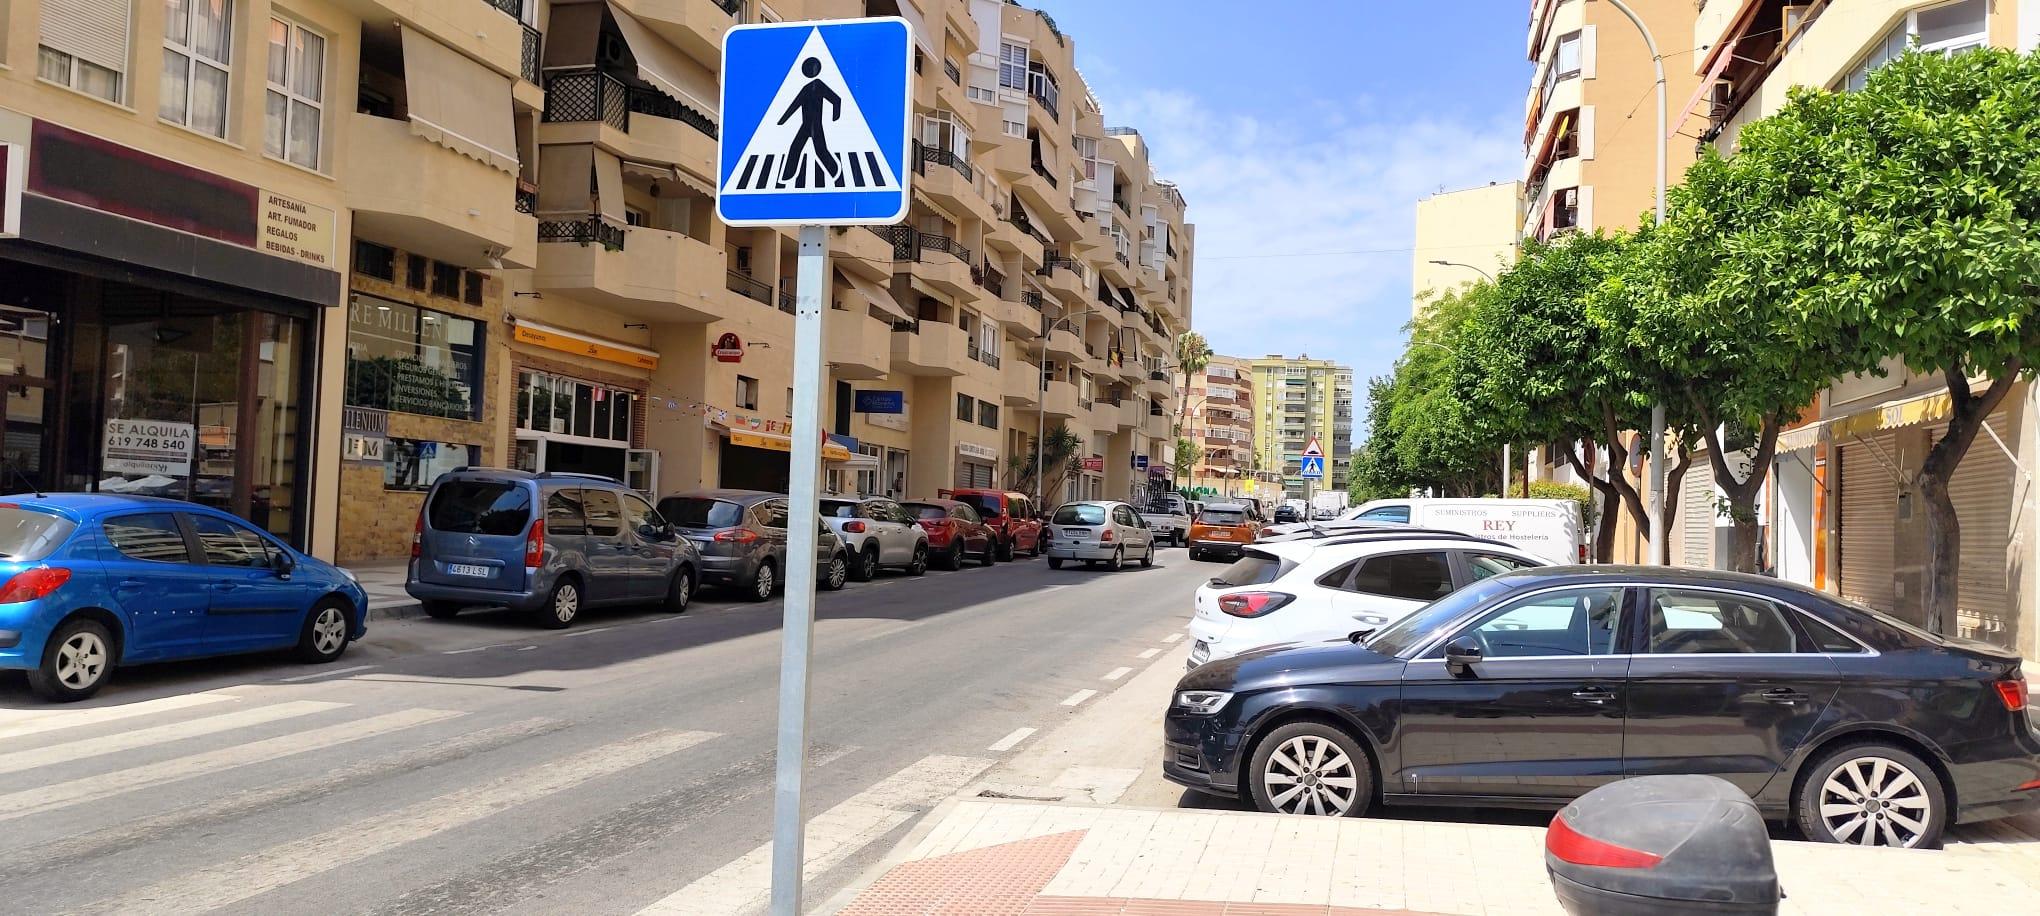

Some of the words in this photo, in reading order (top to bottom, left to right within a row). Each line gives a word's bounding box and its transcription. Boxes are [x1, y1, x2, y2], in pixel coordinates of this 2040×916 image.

[267, 211, 283, 223] ART.
[284, 215, 317, 232] FUMADOR
[266, 225, 298, 242] REGALOS
[266, 240, 295, 256] BEBIDAS
[300, 249, 325, 263] DRINKS
[109, 423, 124, 434] SE
[129, 425, 189, 438] ALQUILA
[108, 437, 131, 446] 619
[136, 438, 158, 448] 748
[162, 440, 185, 450] 540
[1434, 509, 1488, 517] SUMINISTROS
[1511, 510, 1557, 519] SUPPLIERS
[1483, 520, 1516, 531] REY
